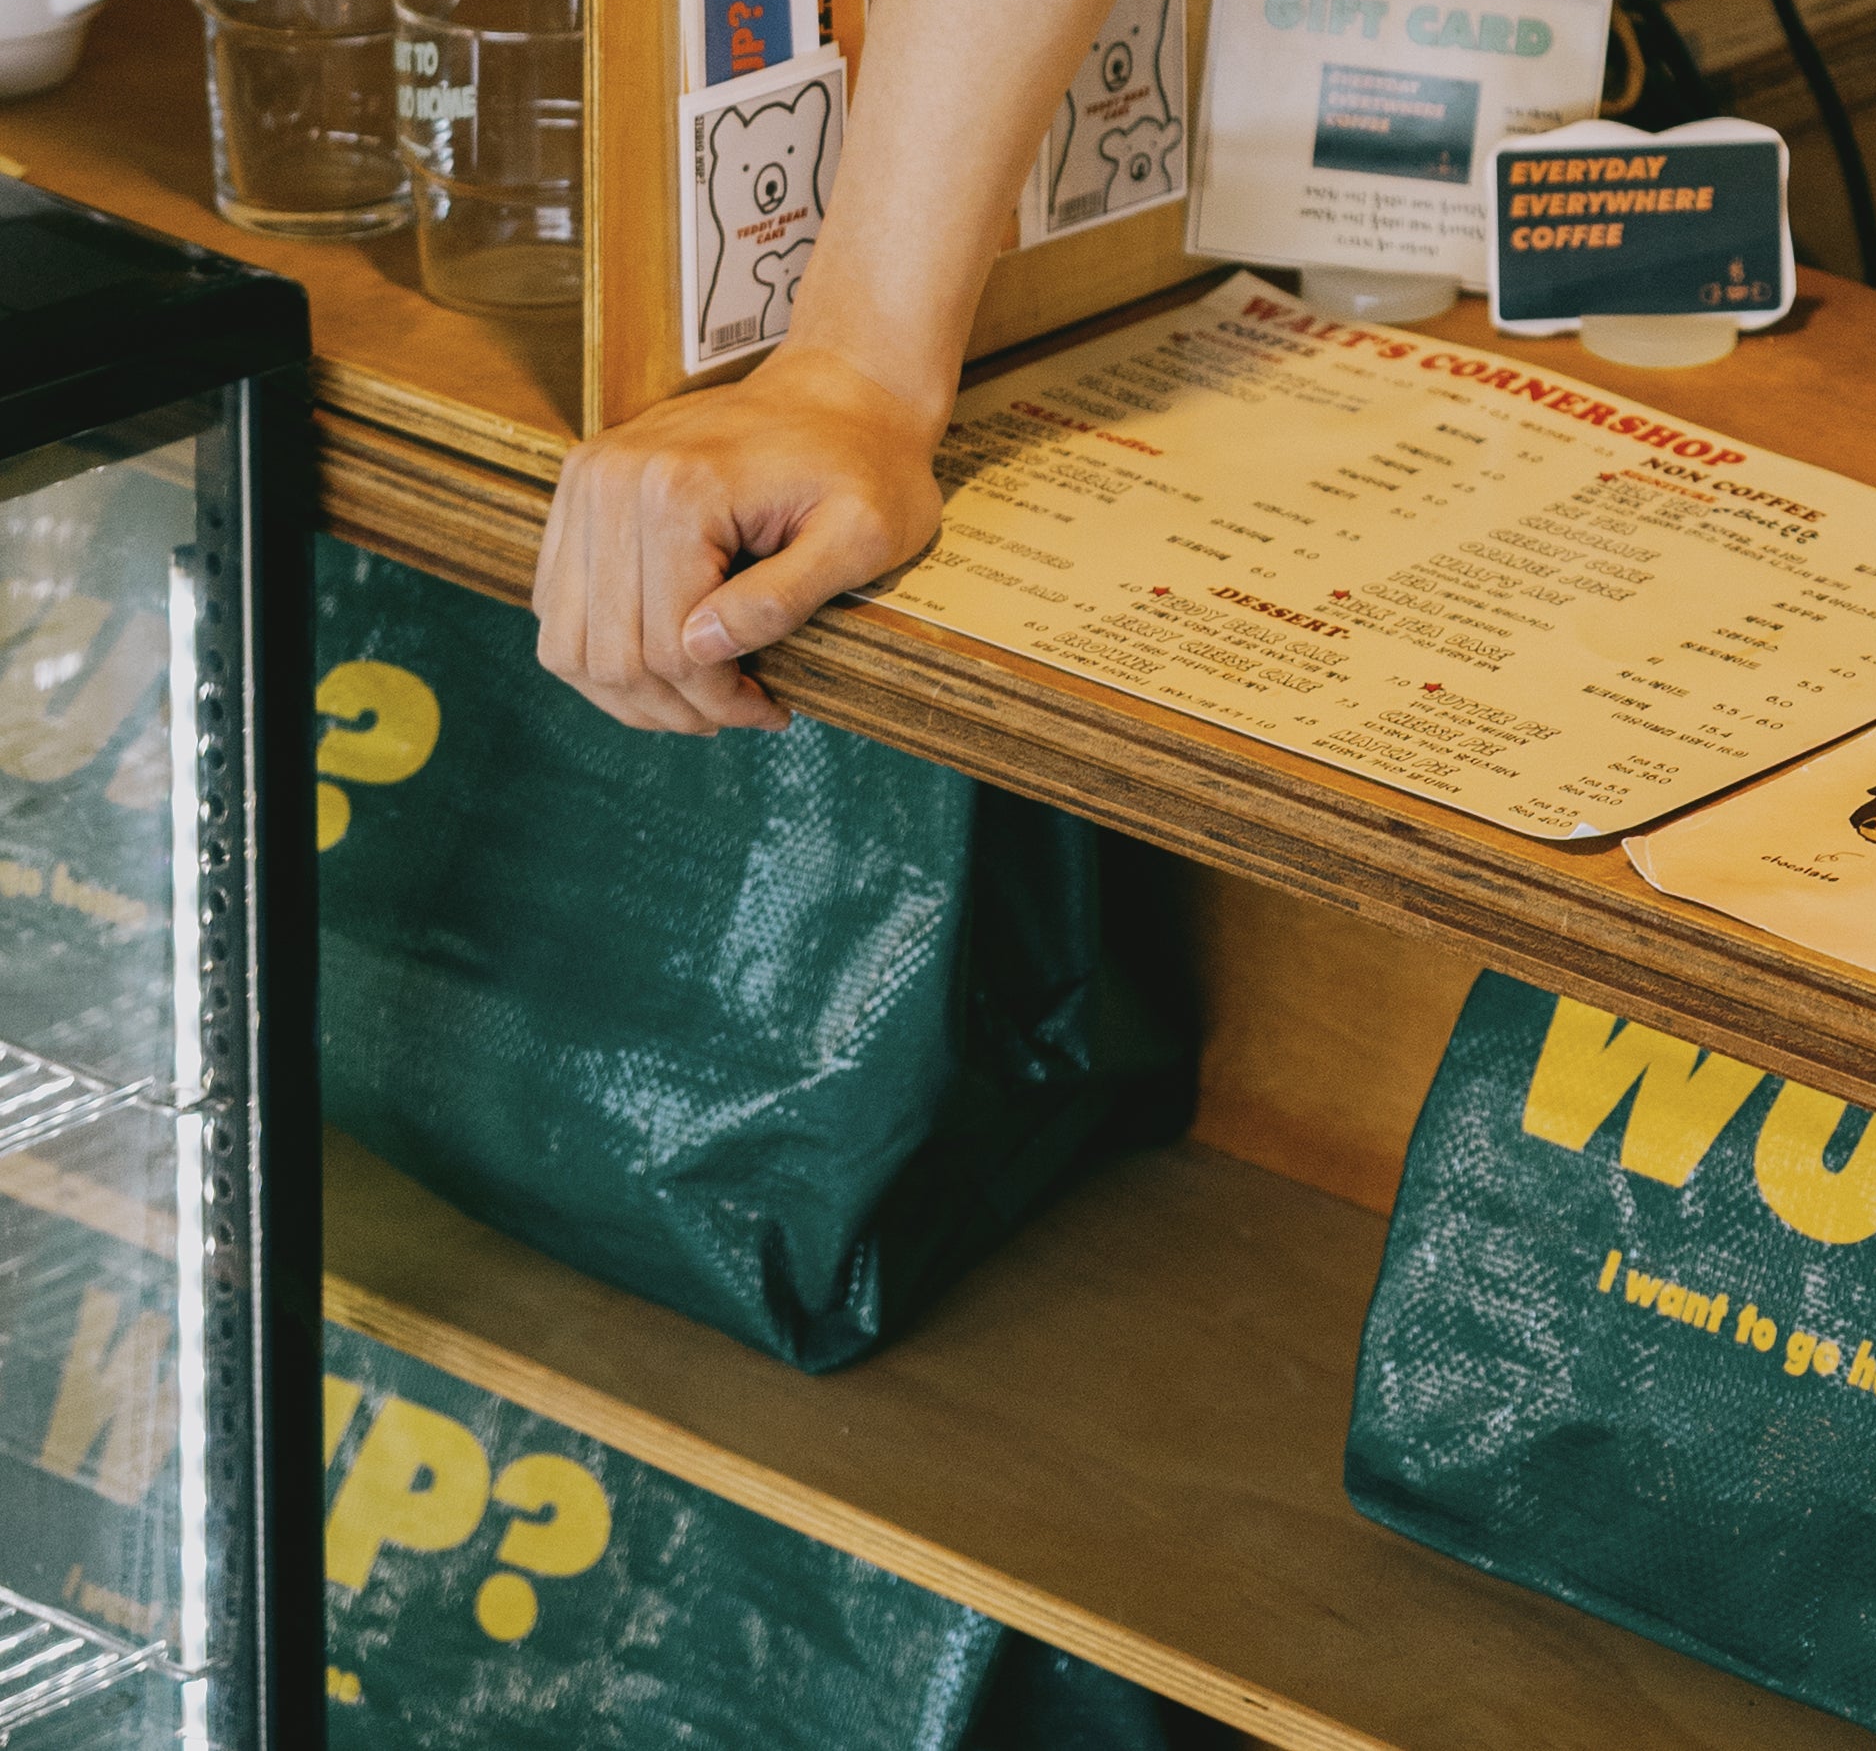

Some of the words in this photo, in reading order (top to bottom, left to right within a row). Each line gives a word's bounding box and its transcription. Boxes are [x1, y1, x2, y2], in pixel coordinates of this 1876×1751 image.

[1405, 4, 1554, 58] CARD
[1509, 155, 1667, 186] EVERYDAY
[1509, 186, 1716, 219] EVERYWHERE
[736, 219, 777, 242] TEDDY
[755, 227, 787, 246] CAKE
[1509, 222, 1626, 251] COFFEE
[1242, 297, 1419, 360] WALT'S
[1419, 352, 1748, 467] CORNERSHOP
[1640, 456, 1711, 483] NON
[1712, 480, 1827, 524] COFFEE
[1455, 538, 1563, 579] ORANGE
[1098, 610, 1185, 645] JERRY
[1174, 638, 1263, 673] CHEESE
[1254, 666, 1325, 694] CAKE
[1219, 617, 1289, 645] BEAR
[1280, 638, 1350, 666] CAKE
[1390, 614, 1453, 639] TEA
[1441, 632, 1517, 662] BASE
[1793, 680, 1827, 693] 5.5
[1825, 666, 1859, 679] 4.0
[1291, 714, 1320, 726] 4.5
[1419, 687, 1521, 727] BUTTER
[1709, 703, 1742, 716] 5.5
[1752, 717, 1785, 731] 6.0
[1374, 706, 1467, 743] CHEESE
[1694, 723, 1735, 739] 15.4
[1326, 727, 1419, 764] MATCH
[1651, 762, 1681, 774] 5.0
[1584, 790, 1625, 807] 40.0
[1601, 783, 1632, 795] 5.5
[1535, 813, 1574, 829] 40.0
[1551, 805, 1582, 818] 5.5
[1760, 853, 1841, 885] chocolate
[1598, 1249, 1623, 1293] I
[1624, 1263, 1730, 1336] want
[1733, 1300, 1778, 1353] to
[1783, 1328, 1840, 1377] go
